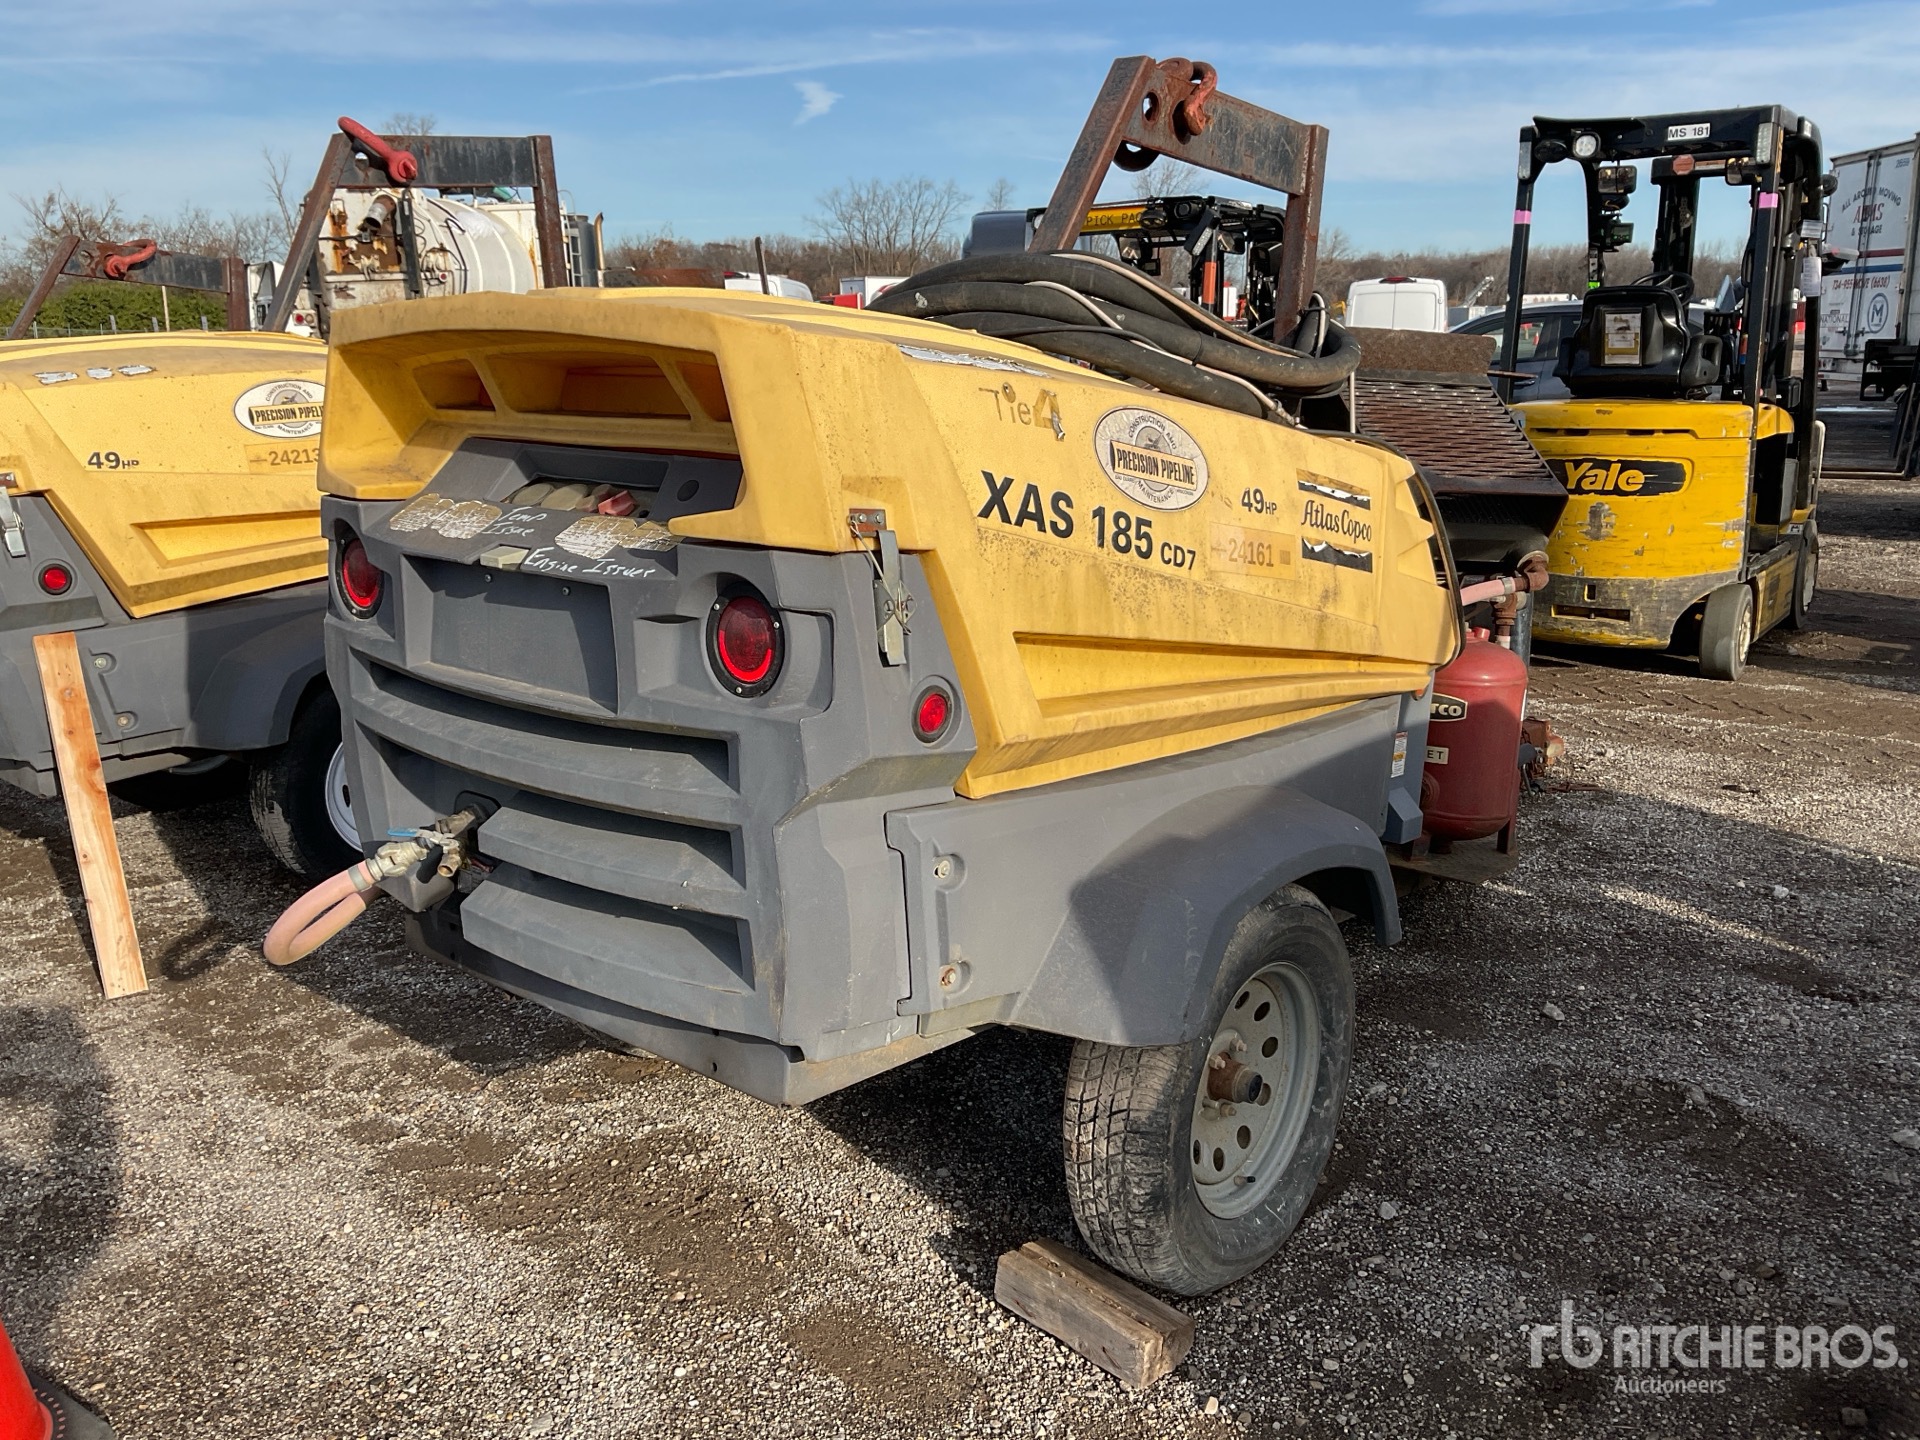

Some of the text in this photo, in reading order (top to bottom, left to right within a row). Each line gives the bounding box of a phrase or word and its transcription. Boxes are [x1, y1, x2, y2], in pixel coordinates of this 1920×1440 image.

[1668, 126, 1709, 139] MS 181
[1879, 186, 1902, 206] MOVING
[1086, 214, 1114, 226] PICK
[265, 382, 313, 402] CONSTRUCTION AND
[254, 407, 297, 423] PRECISION
[277, 422, 314, 435] MAINTENANCE
[1128, 415, 1177, 450] CONSTRUCTION AND
[1116, 448, 1195, 485] PRECISION PIPELINE
[1564, 461, 1646, 491] Yale
[1137, 480, 1175, 503] MAINTENANCE
[977, 470, 1197, 571] XAS 185 CD7
[1300, 499, 1373, 544] Atlas Copco
[523, 546, 579, 574] Engine
[1228, 537, 1274, 568] 24161
[1427, 749, 1444, 760] ET
